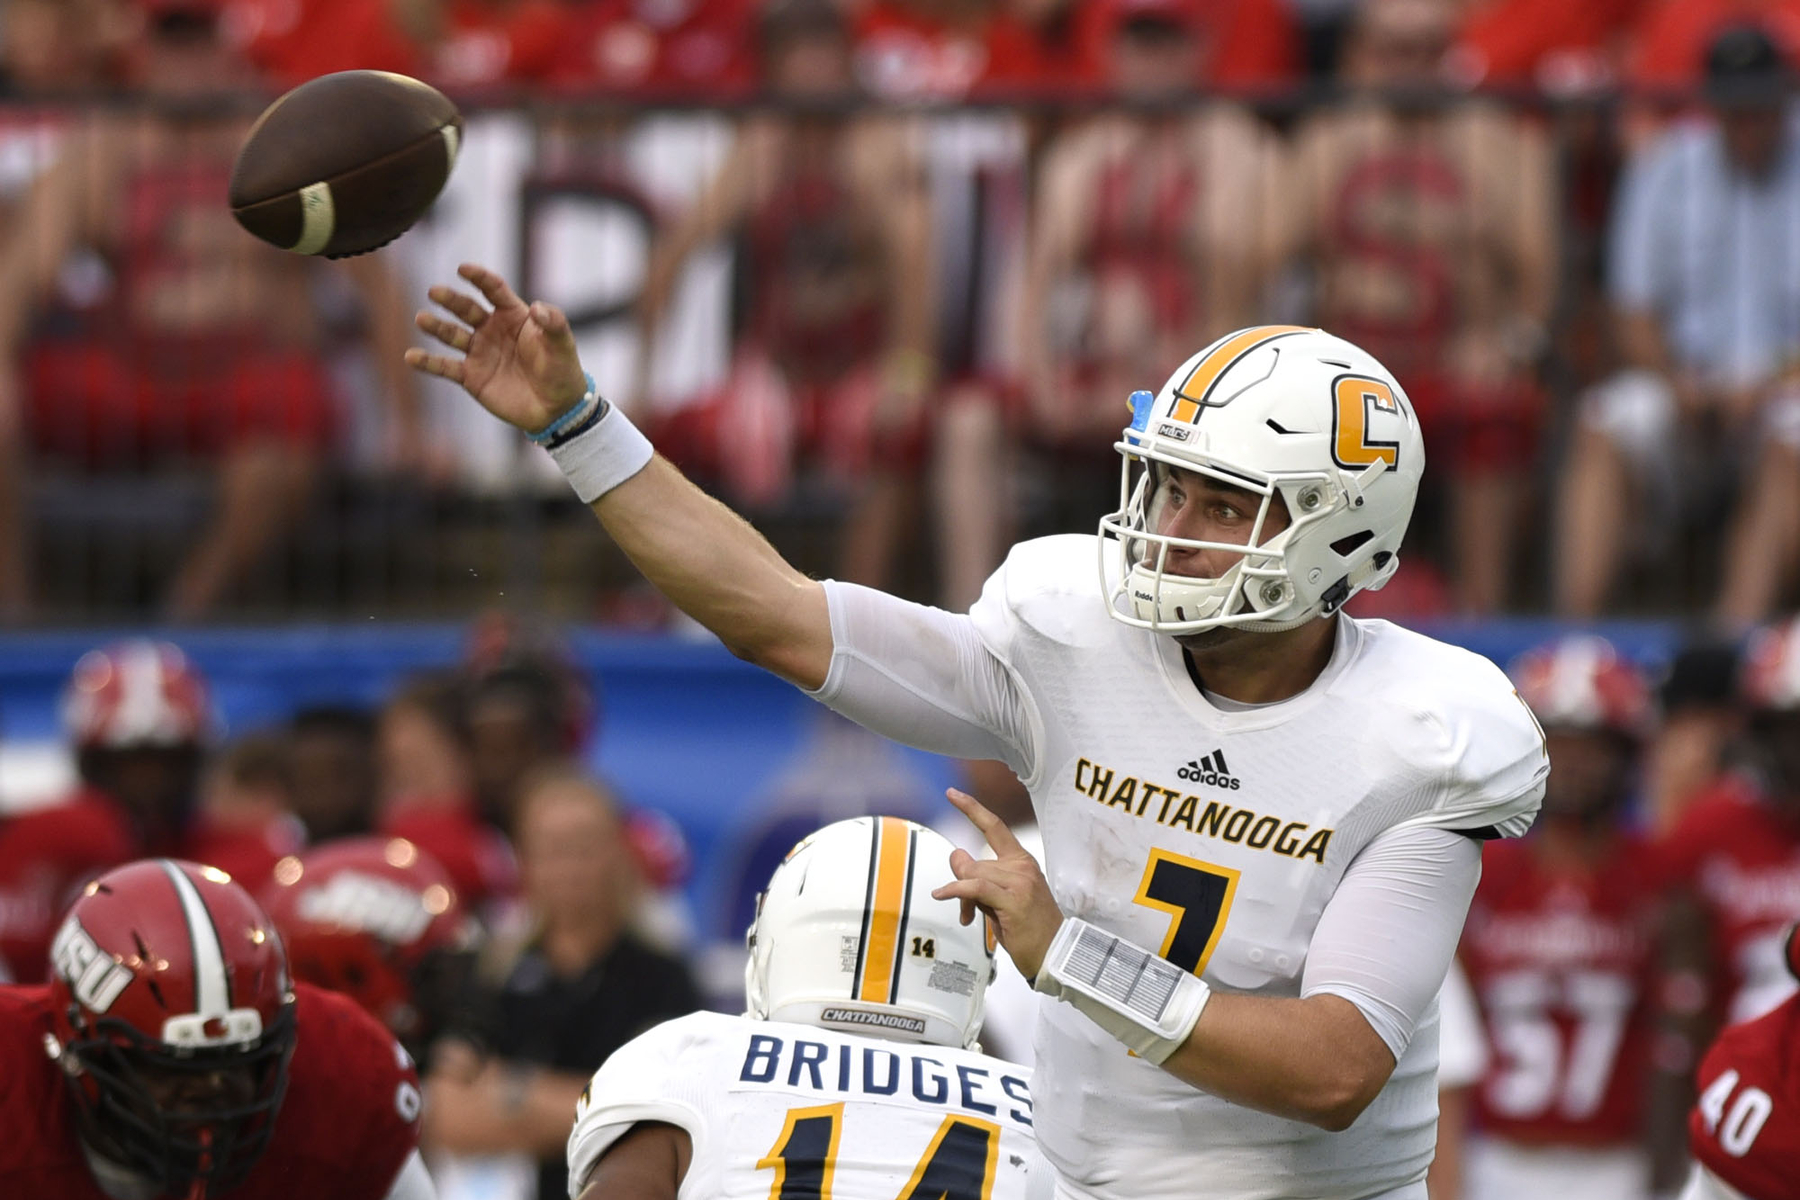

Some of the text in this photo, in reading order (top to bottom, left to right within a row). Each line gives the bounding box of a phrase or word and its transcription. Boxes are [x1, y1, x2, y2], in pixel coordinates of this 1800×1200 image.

[1331, 373, 1399, 471] C
[1075, 757, 1335, 864] CHATTANOOGA
[1177, 767, 1240, 790] adidas
[911, 937, 935, 958] 14
[1132, 847, 1241, 979] 7
[823, 1009, 924, 1033] CHATTANOOGA
[1490, 972, 1635, 1120] 57
[739, 1034, 1034, 1128] BRIDGES
[1701, 1069, 1773, 1157] 40
